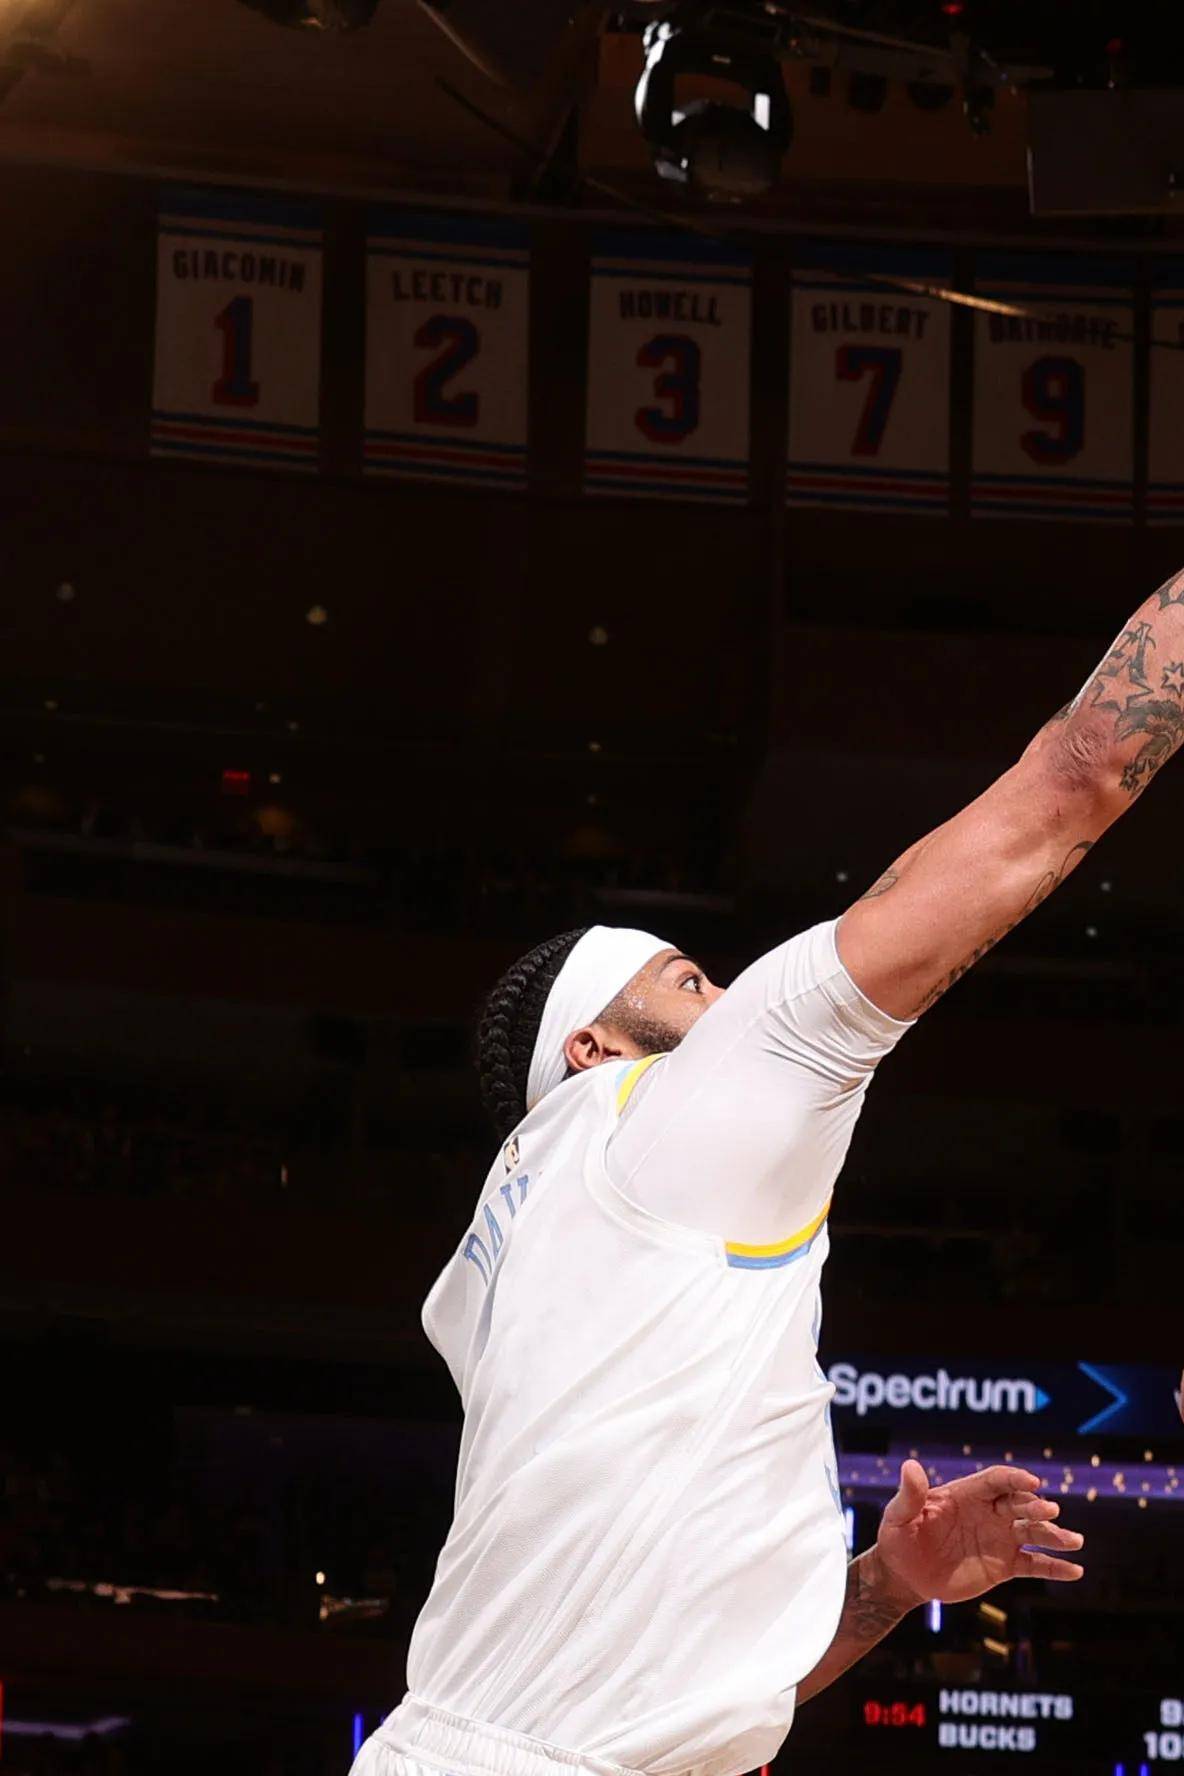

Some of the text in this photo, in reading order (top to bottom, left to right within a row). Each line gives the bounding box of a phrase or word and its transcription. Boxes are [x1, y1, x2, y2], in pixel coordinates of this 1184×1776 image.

[173, 250, 305, 292] GIACOMIN
[392, 268, 501, 308] LEETCH
[619, 289, 722, 325] HOWELL
[812, 304, 930, 340] GILBERT
[213, 295, 259, 406] 1
[413, 314, 480, 427] 2
[635, 332, 700, 443] 3
[835, 344, 902, 456] 7
[1021, 355, 1086, 466] 9
[829, 1362, 1037, 1416] Spectrum
[939, 1689, 1073, 1719] HORNETS
[938, 1722, 1036, 1751] BUCKS
